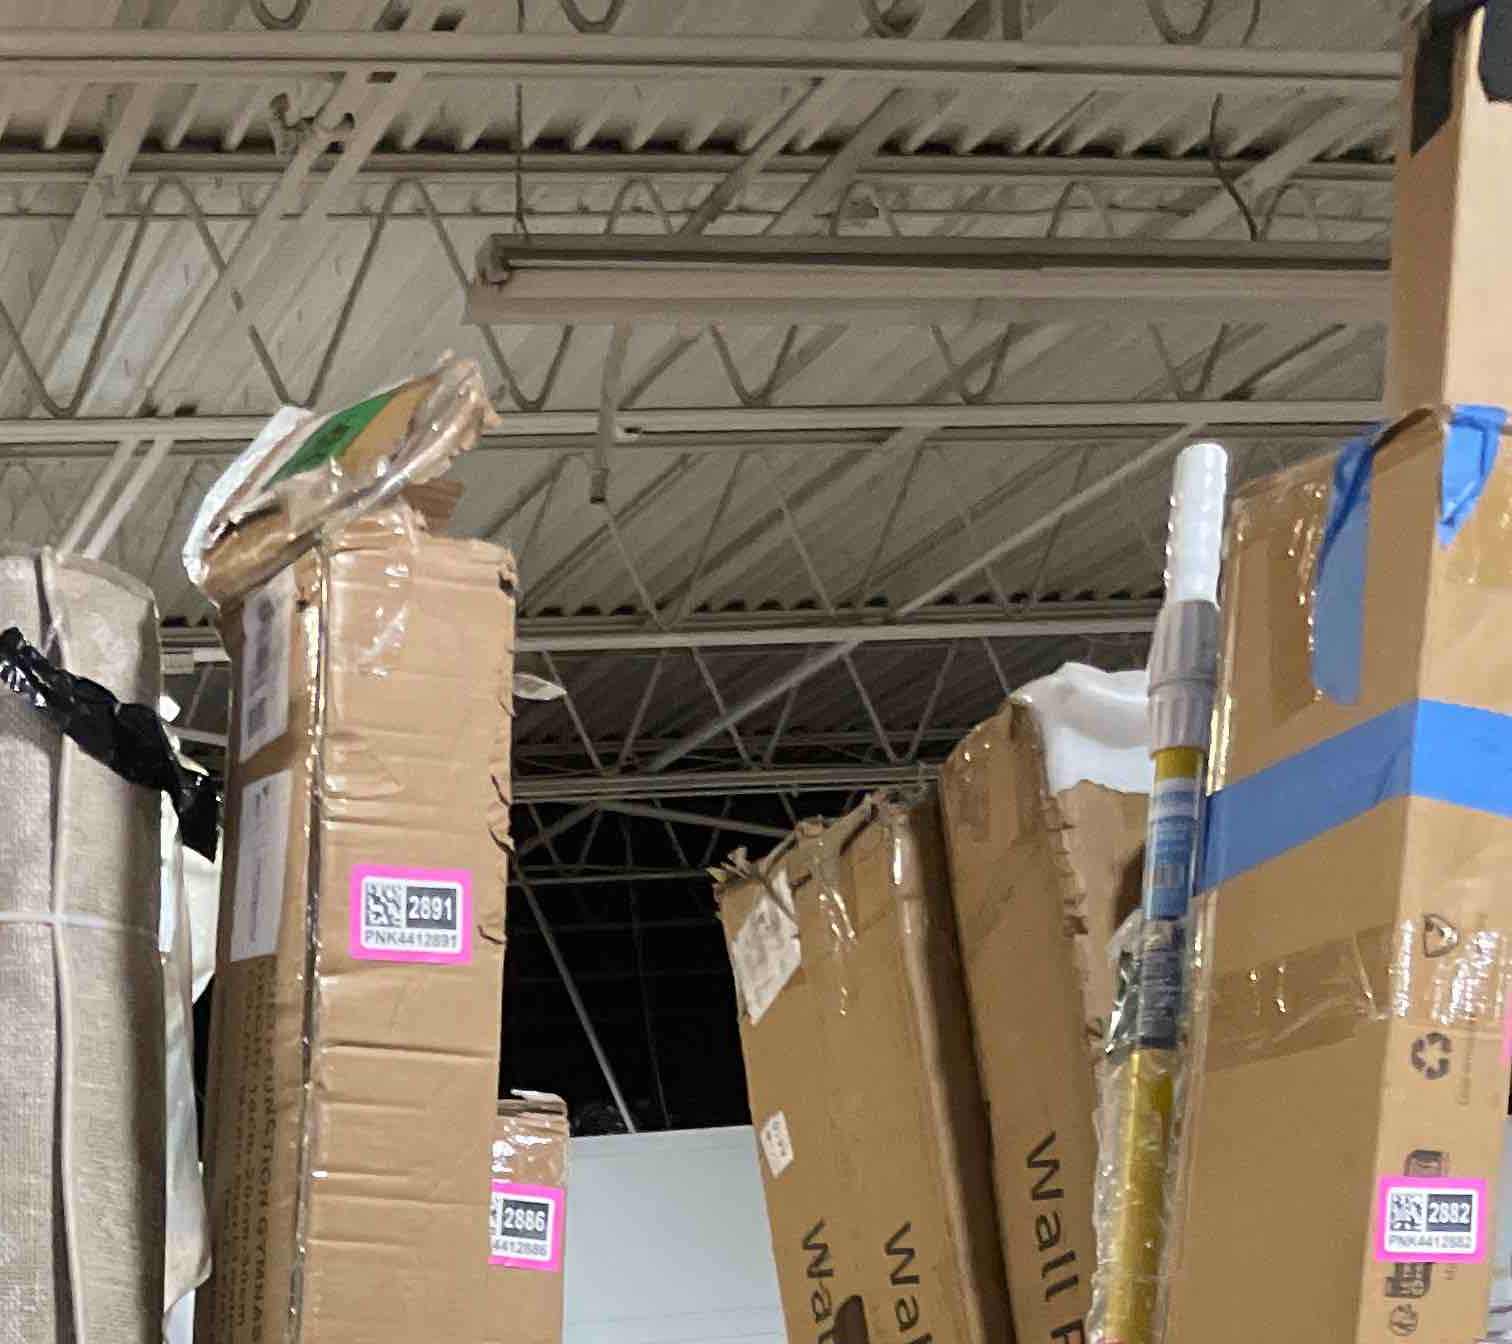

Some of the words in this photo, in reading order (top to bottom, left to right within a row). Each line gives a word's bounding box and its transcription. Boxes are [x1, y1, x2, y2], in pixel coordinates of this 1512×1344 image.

[408, 895, 454, 921] 2891
[365, 929, 457, 949] PNK4412891
[503, 1206, 547, 1232] 2886
[1027, 1131, 1080, 1303] Wall
[1427, 1202, 1471, 1224] 2882
[492, 1238, 548, 1257] 4412886
